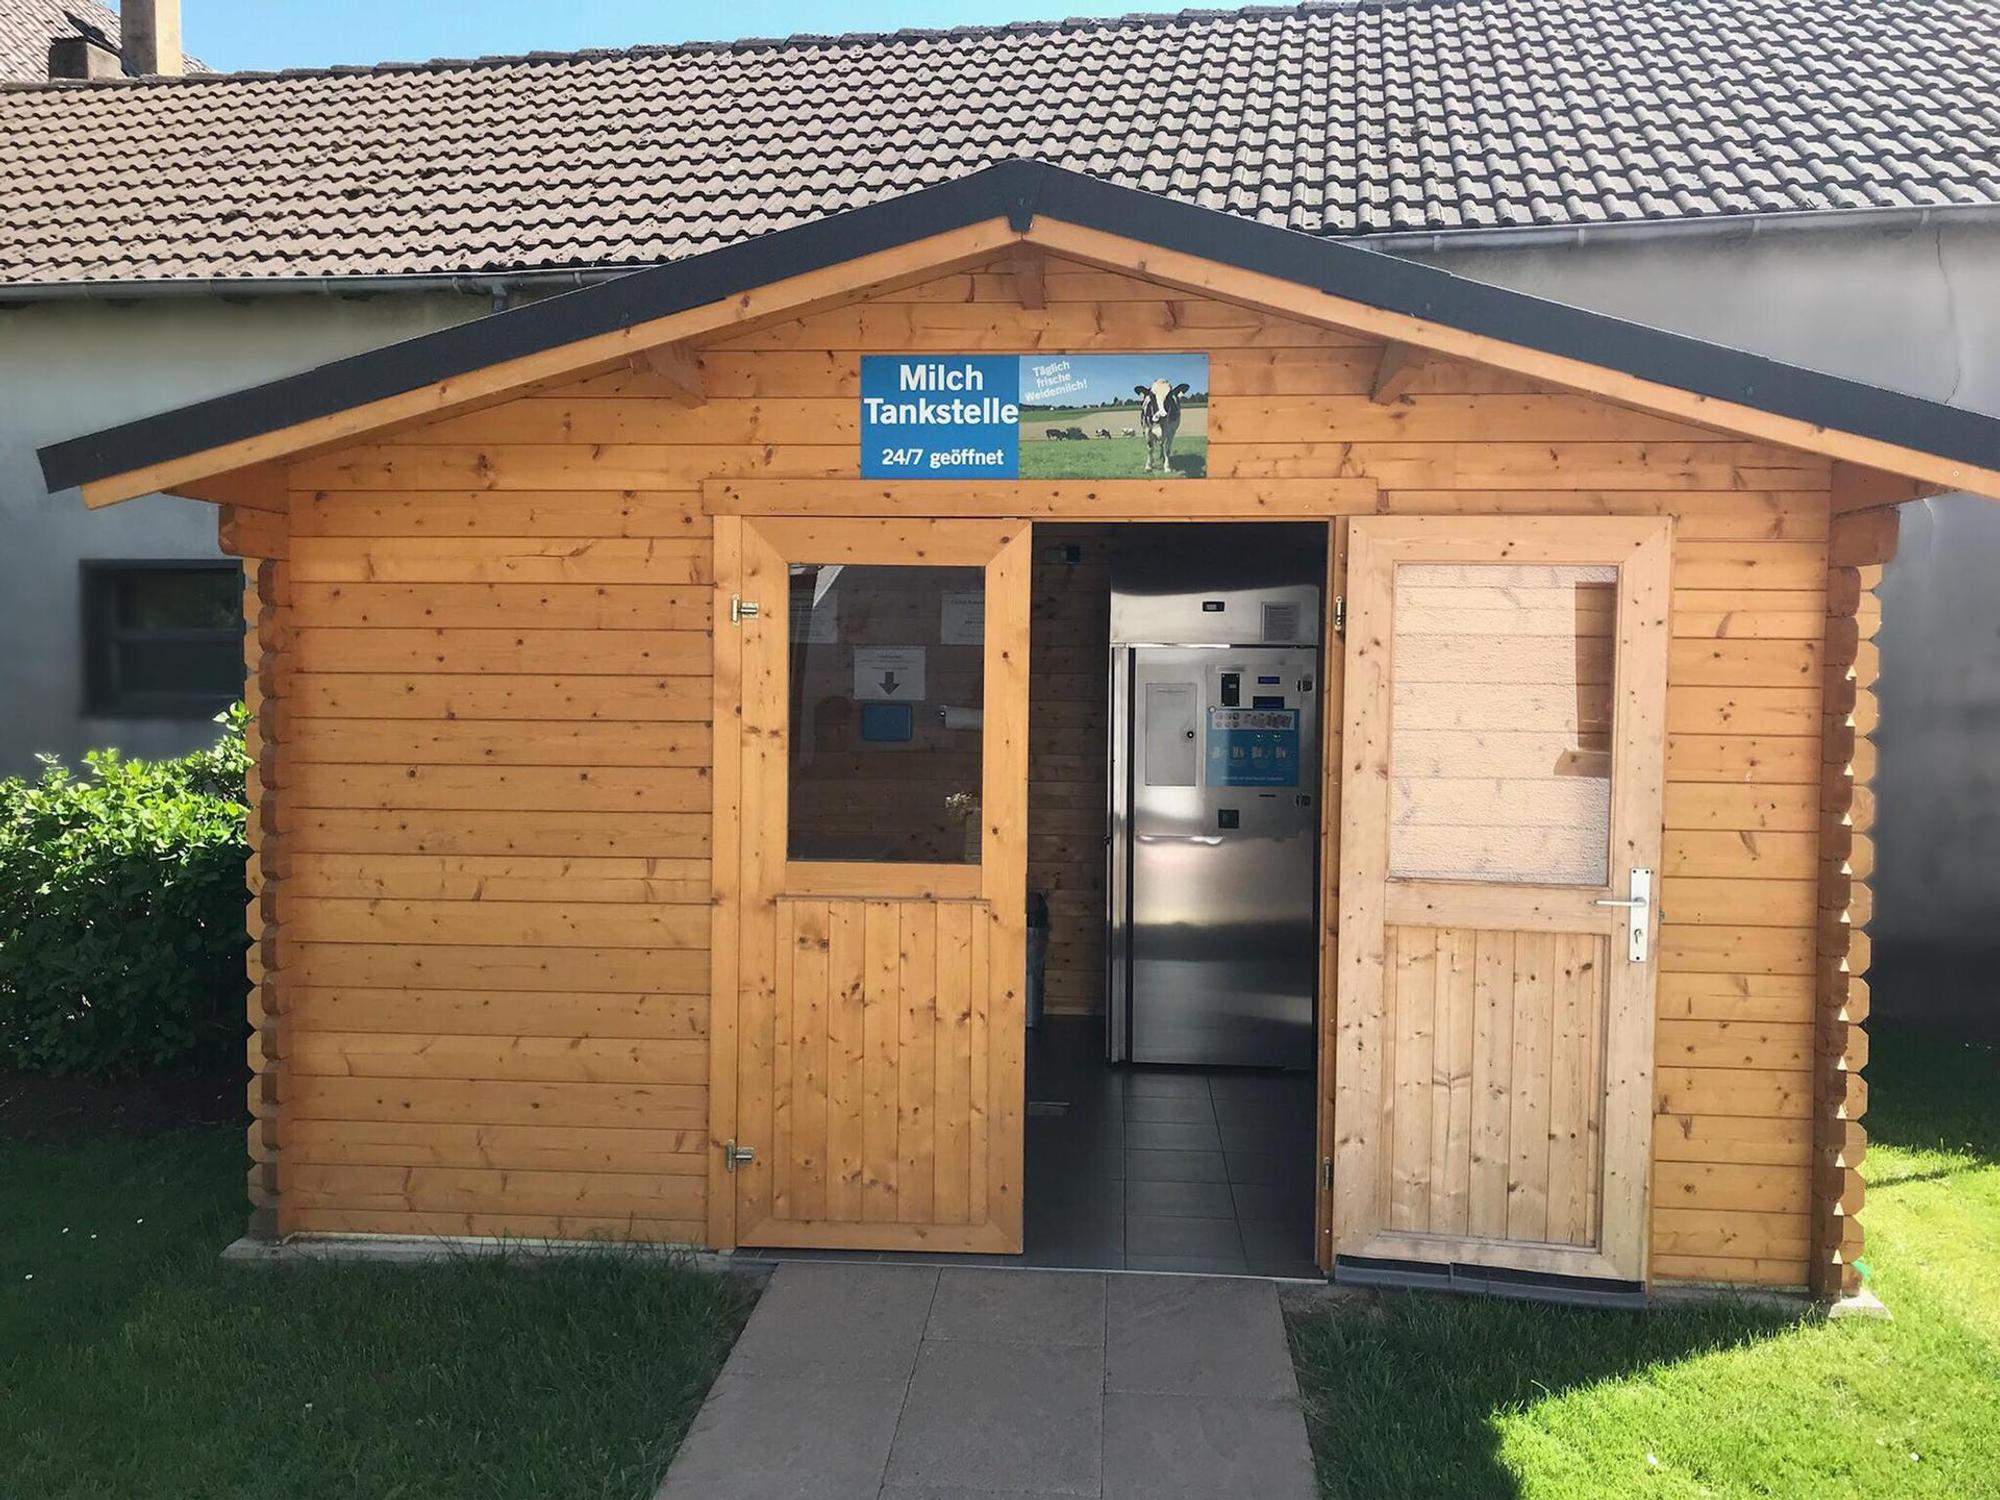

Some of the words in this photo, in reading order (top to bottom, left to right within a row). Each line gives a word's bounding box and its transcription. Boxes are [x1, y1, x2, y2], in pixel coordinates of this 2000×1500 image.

[900, 363, 983, 391] Milch
[1032, 360, 1070, 377] Täglich
[1024, 378, 1088, 402] Weidemilch!
[1036, 372, 1071, 389] frische
[863, 397, 1019, 425] Tankstelle
[882, 449, 923, 466] 24/7
[930, 448, 1004, 468] geöffnet
